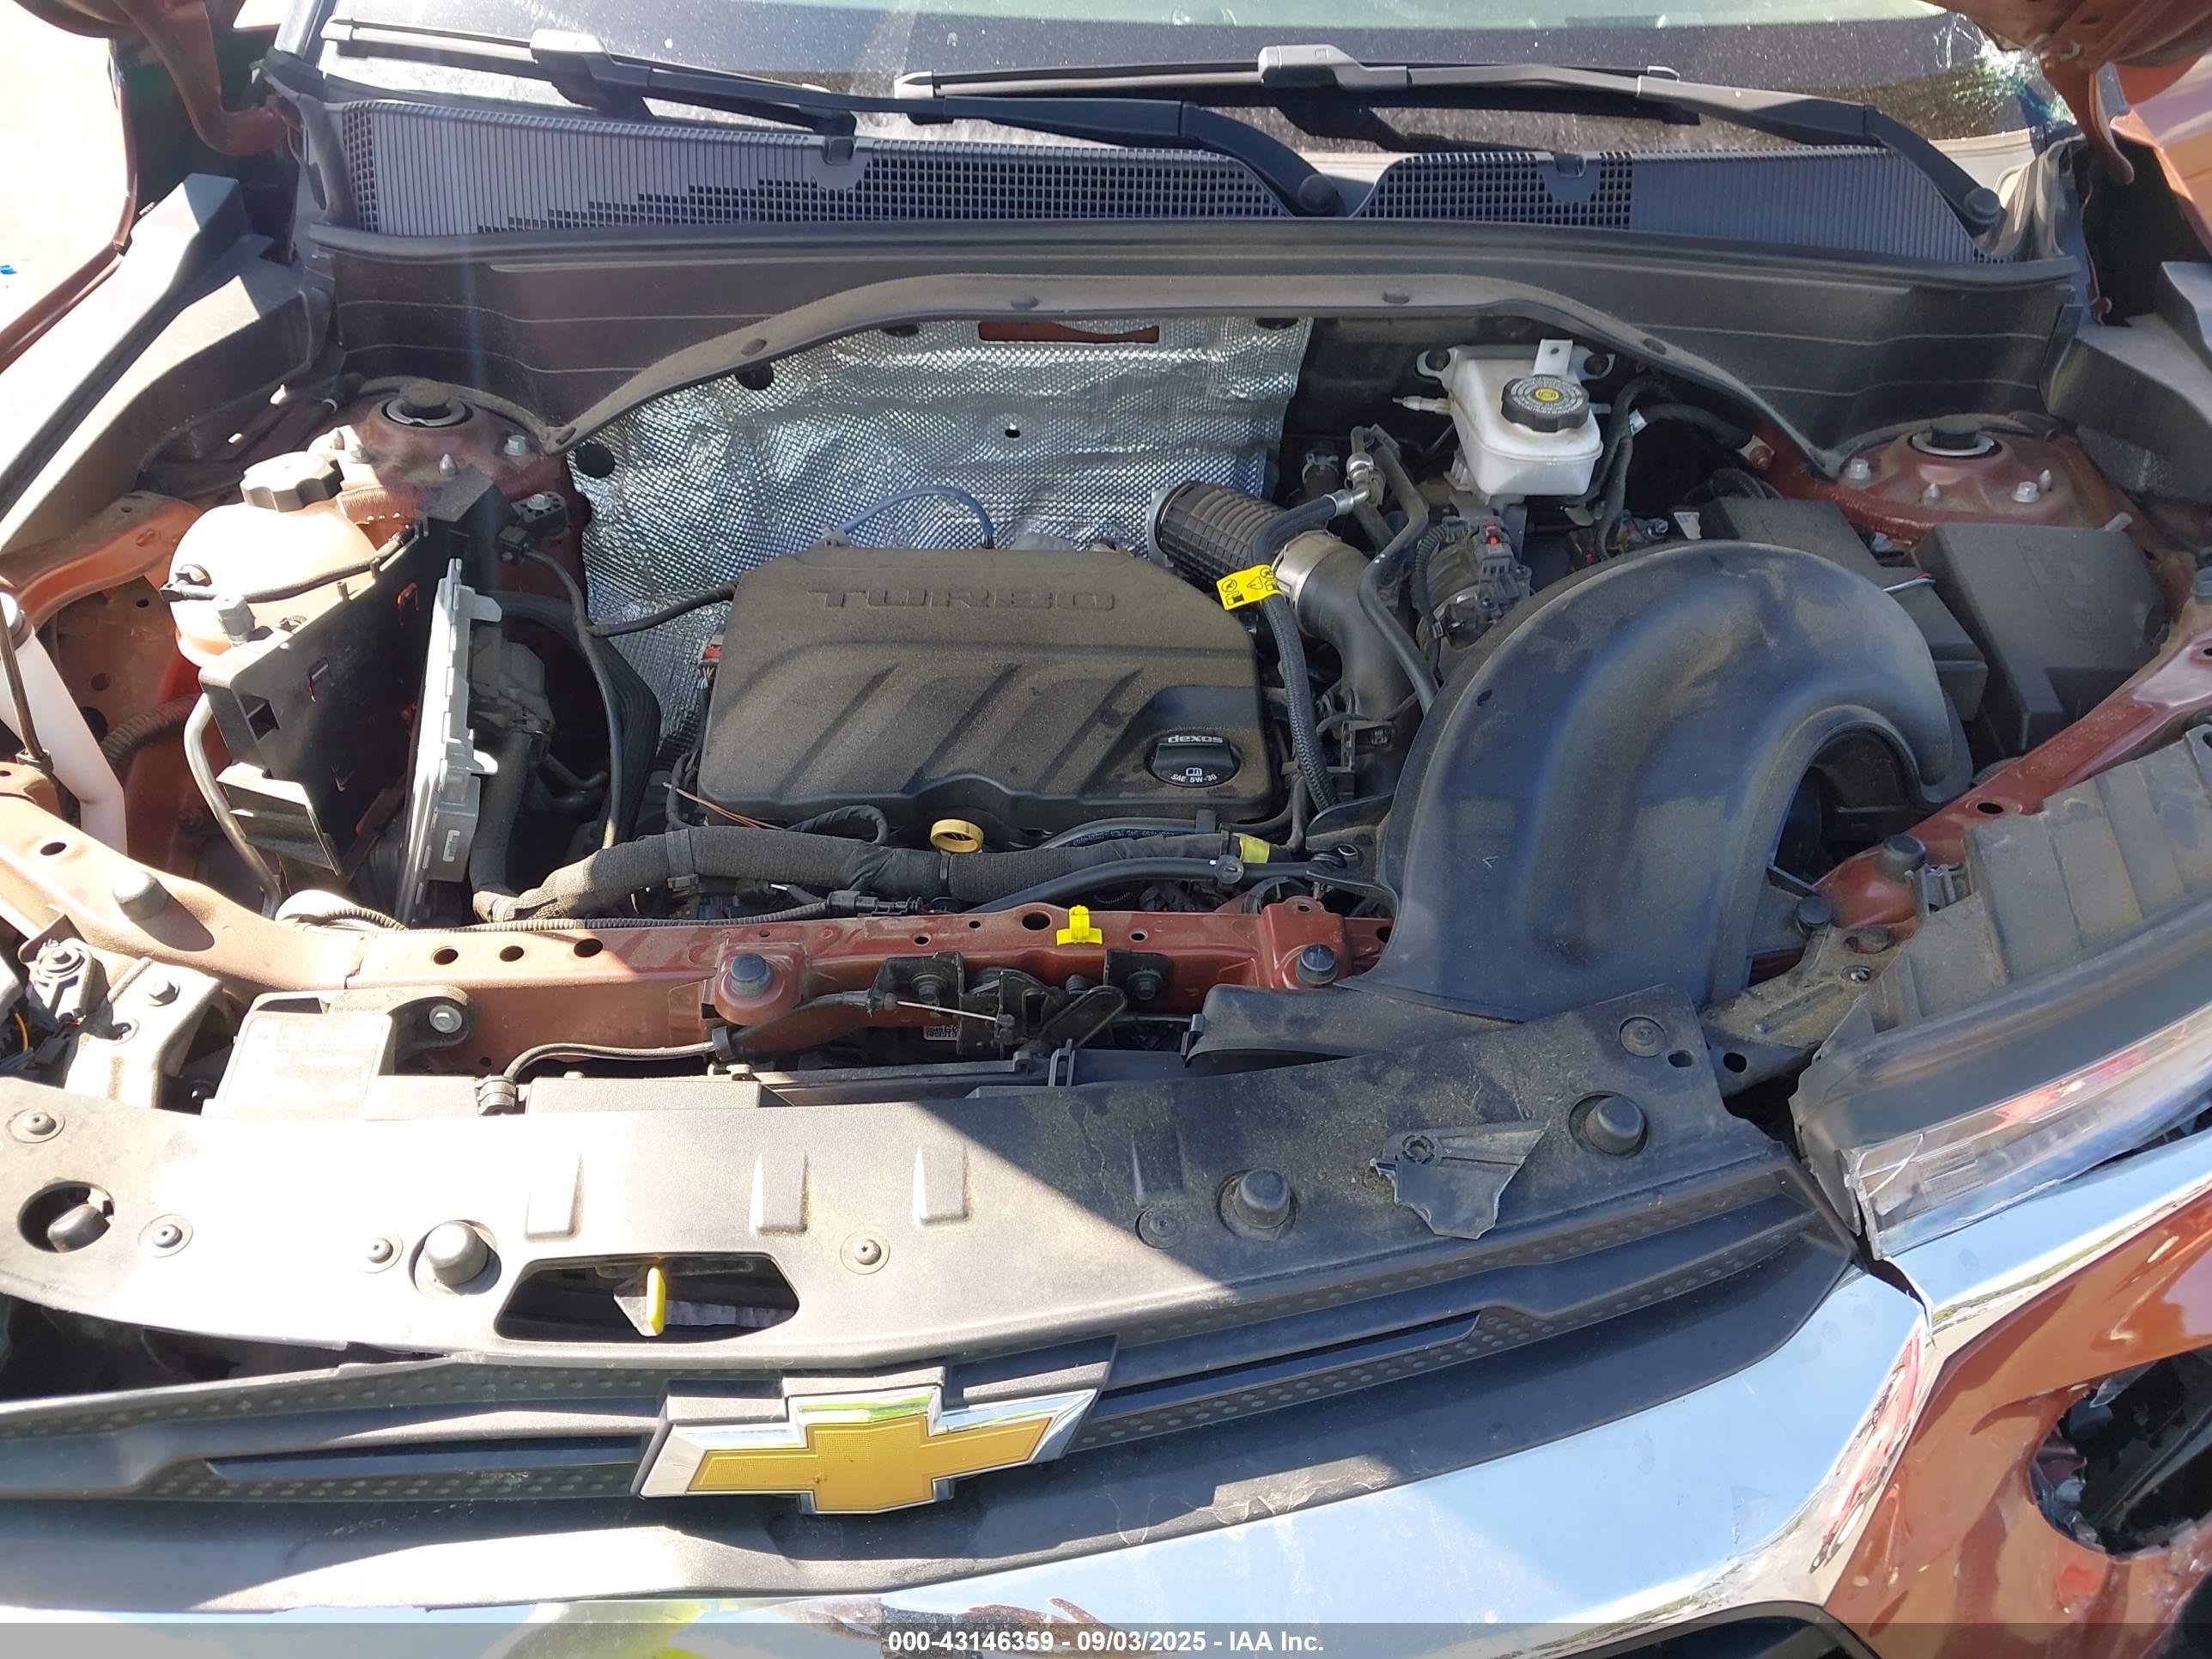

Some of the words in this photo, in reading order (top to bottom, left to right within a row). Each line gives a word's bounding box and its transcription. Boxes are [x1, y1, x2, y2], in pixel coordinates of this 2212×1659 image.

[807, 590, 1115, 611] TURBO
[1168, 734, 1224, 744] dexos
[1170, 774, 1187, 782] SAE
[1189, 774, 1218, 783] 5W-30
